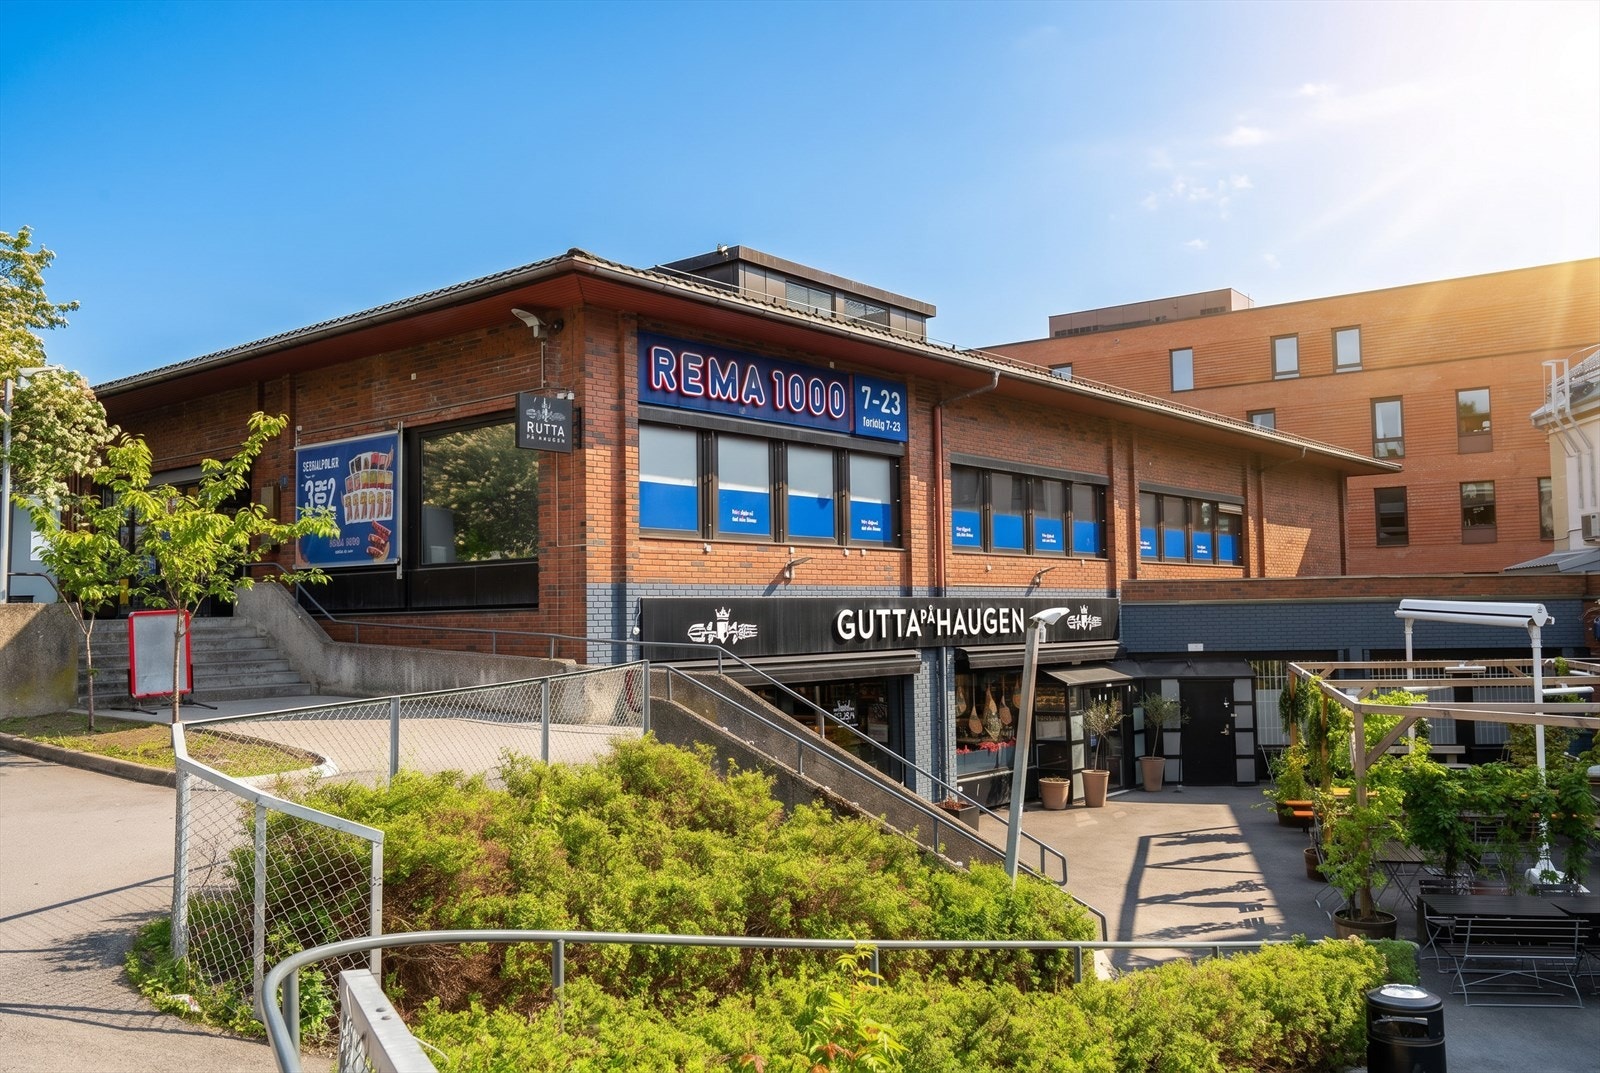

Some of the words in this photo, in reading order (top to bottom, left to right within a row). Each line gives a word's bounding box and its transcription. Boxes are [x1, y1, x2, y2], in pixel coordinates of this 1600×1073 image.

[649, 345, 766, 407] REMA
[771, 369, 846, 421] 1000
[861, 385, 901, 415] 7-23
[526, 421, 565, 436] RUTTA
[327, 477, 337, 511] 2
[837, 607, 922, 640] GUTTA
[920, 605, 936, 624] PÅ
[936, 607, 1025, 636] HAUGEN
